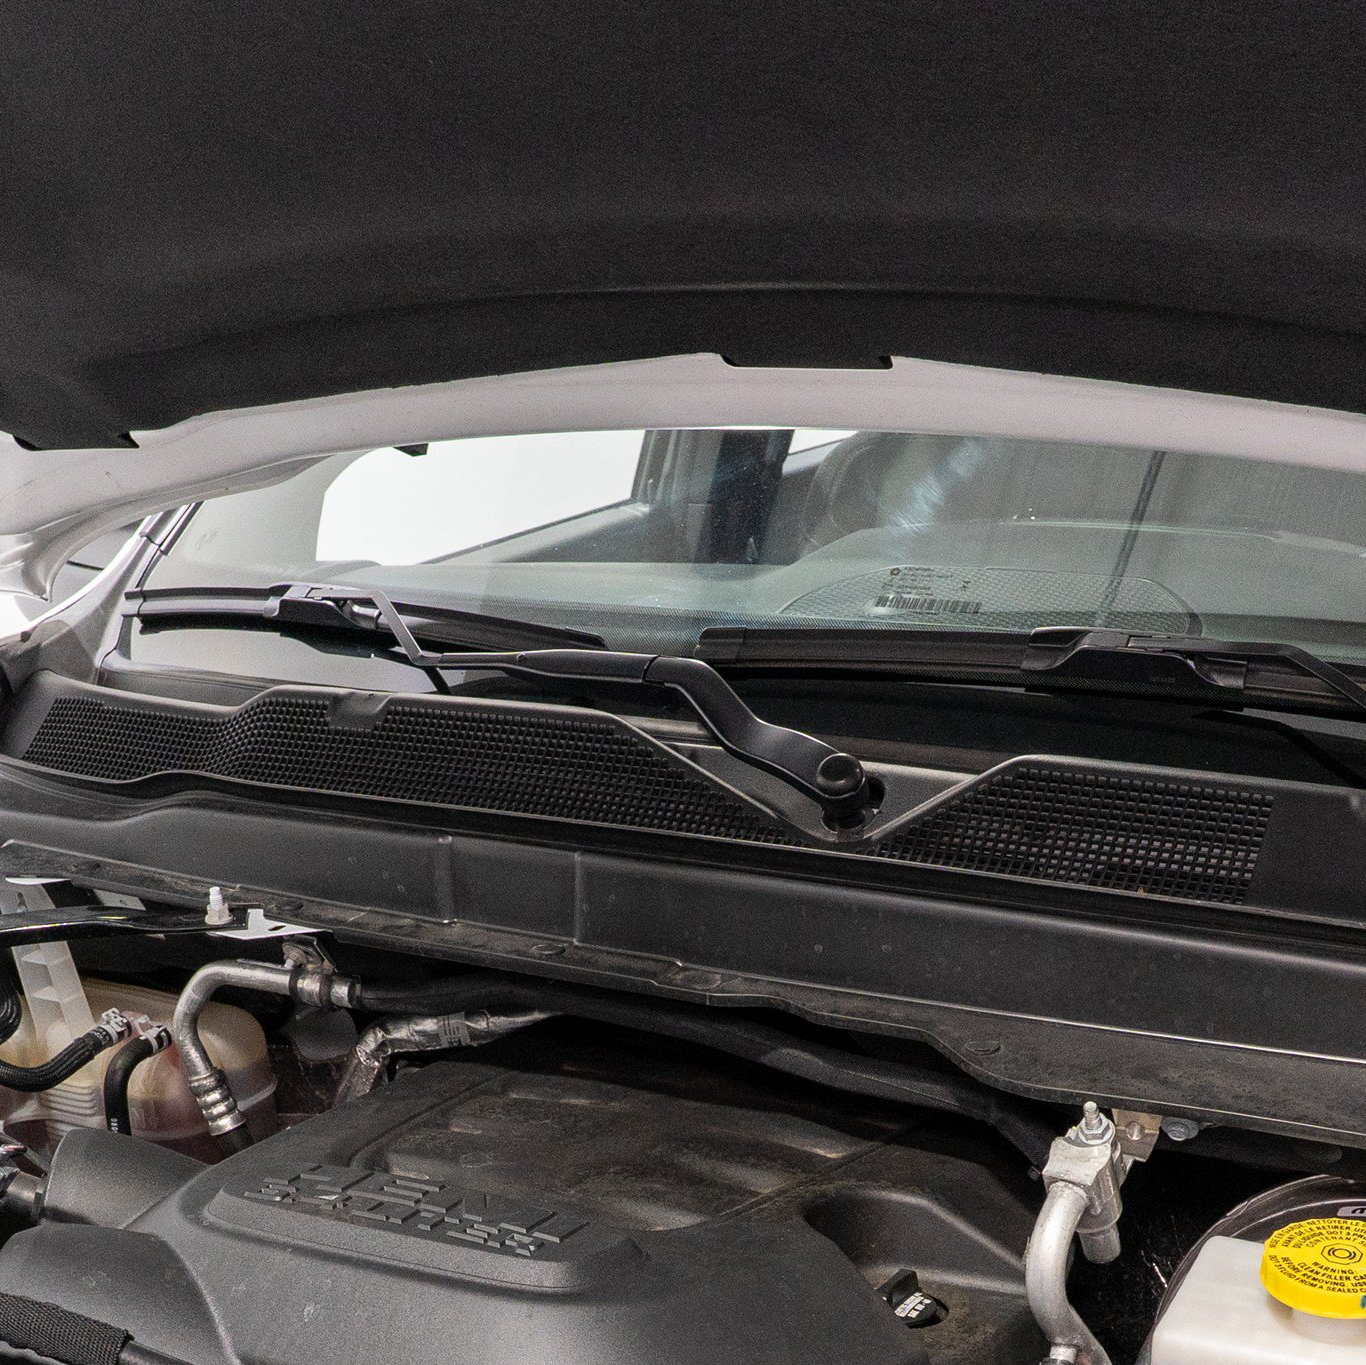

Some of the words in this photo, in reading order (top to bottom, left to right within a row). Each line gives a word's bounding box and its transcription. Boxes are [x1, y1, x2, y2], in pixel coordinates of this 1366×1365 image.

[262, 1162, 591, 1243] HEMI
[1306, 1236, 1358, 1248] CONTENANT
[1281, 1256, 1302, 1273] BEFORE
[1298, 1262, 1321, 1275] CLEAN
[1321, 1273, 1351, 1281] FILLER
[1295, 1277, 1318, 1287] FROM
